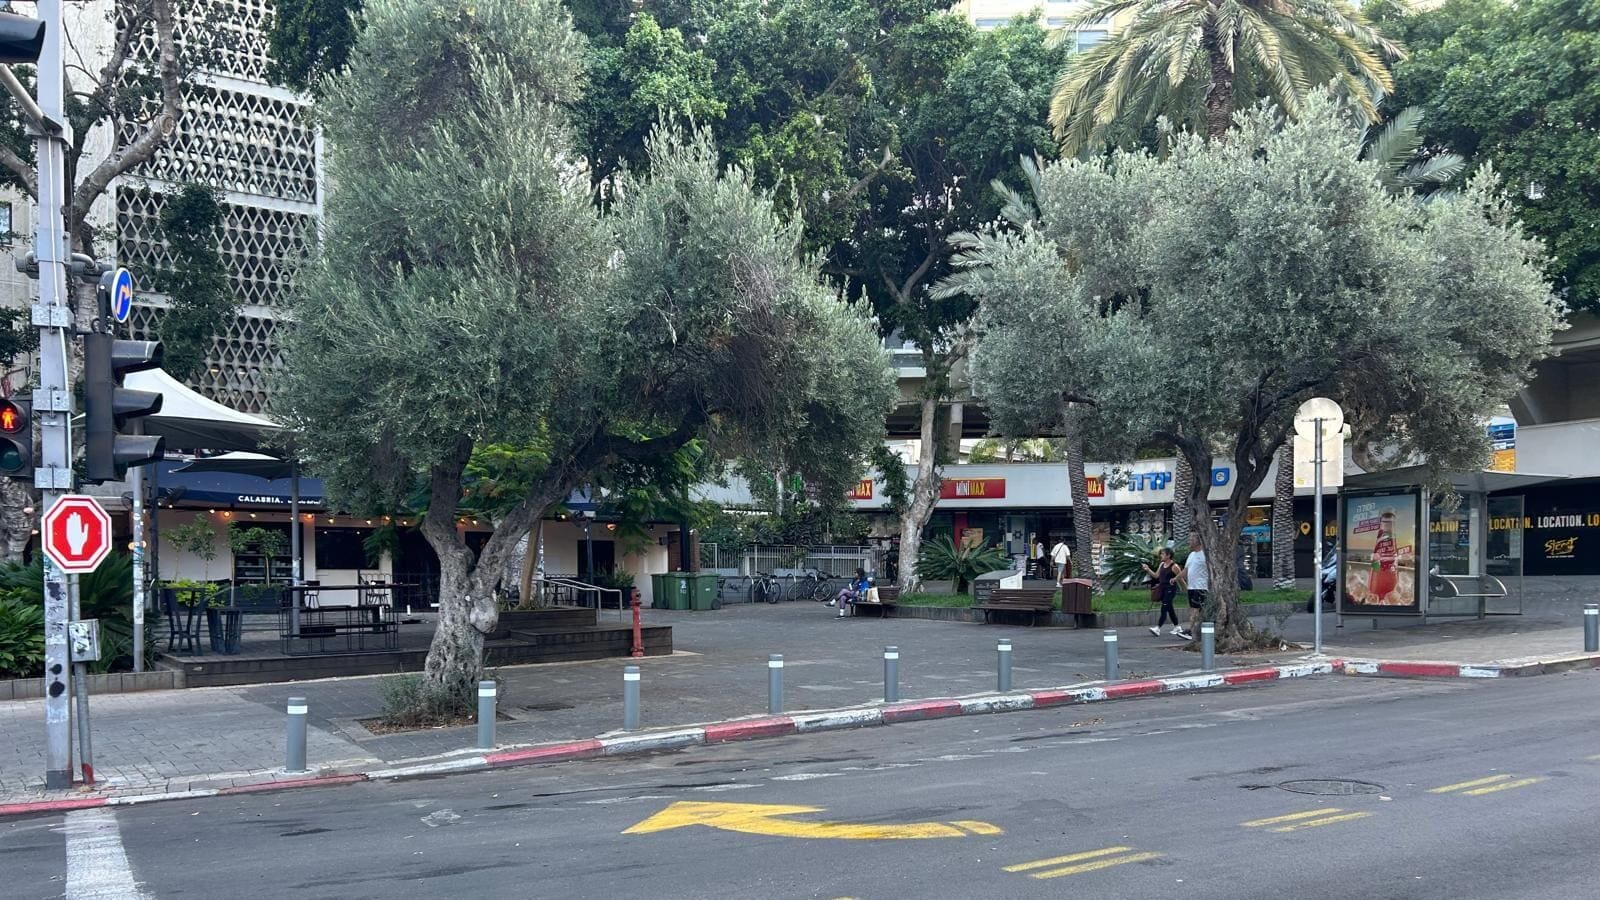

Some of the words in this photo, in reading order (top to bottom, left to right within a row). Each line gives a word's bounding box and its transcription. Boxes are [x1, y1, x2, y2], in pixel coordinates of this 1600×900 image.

[238, 495, 284, 504] CALABRIA.
[1488, 516, 1534, 530] LOCATIN.
[1537, 514, 1585, 528] LOCATION.
